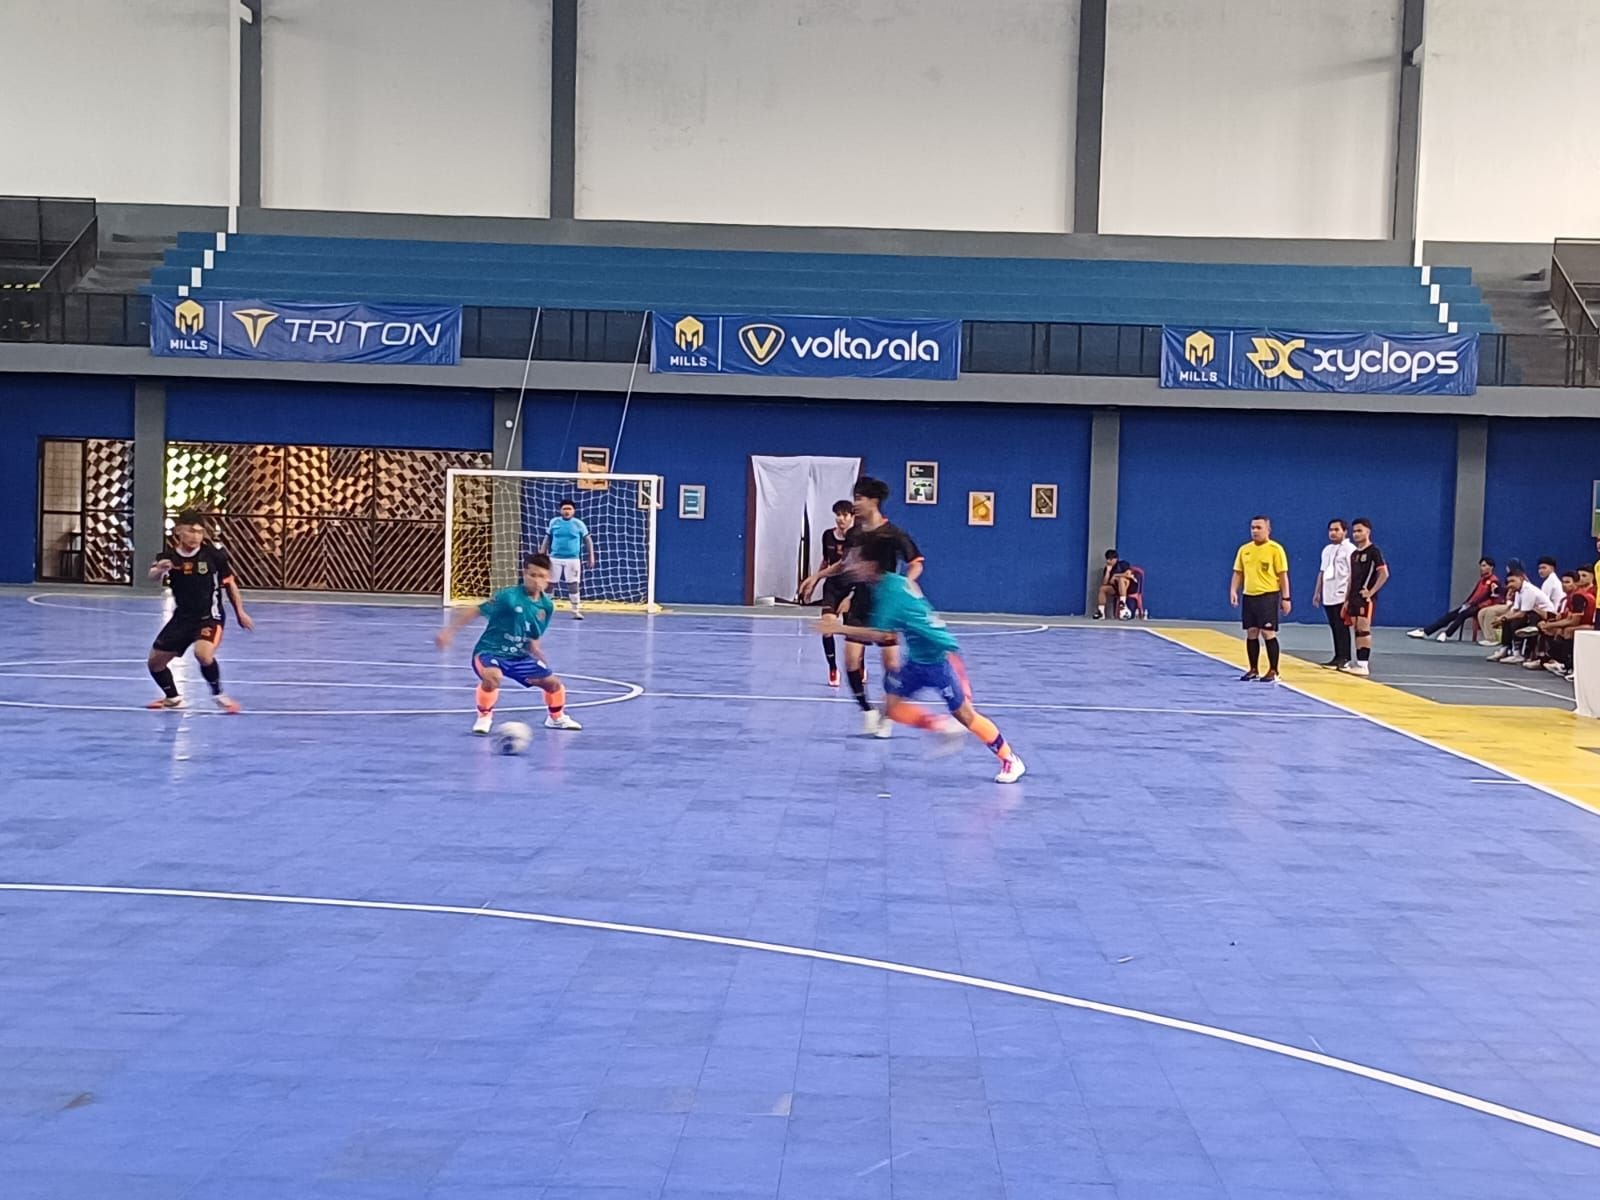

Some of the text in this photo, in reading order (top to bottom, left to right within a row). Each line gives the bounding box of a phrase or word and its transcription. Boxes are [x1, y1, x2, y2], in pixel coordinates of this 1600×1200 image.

[170, 339, 208, 351] MILLS
[284, 318, 441, 350] TRITON
[790, 327, 939, 362] voltasala
[669, 355, 708, 367] MILLS
[1312, 341, 1459, 382] xyclops
[1179, 371, 1218, 383] MILLS
